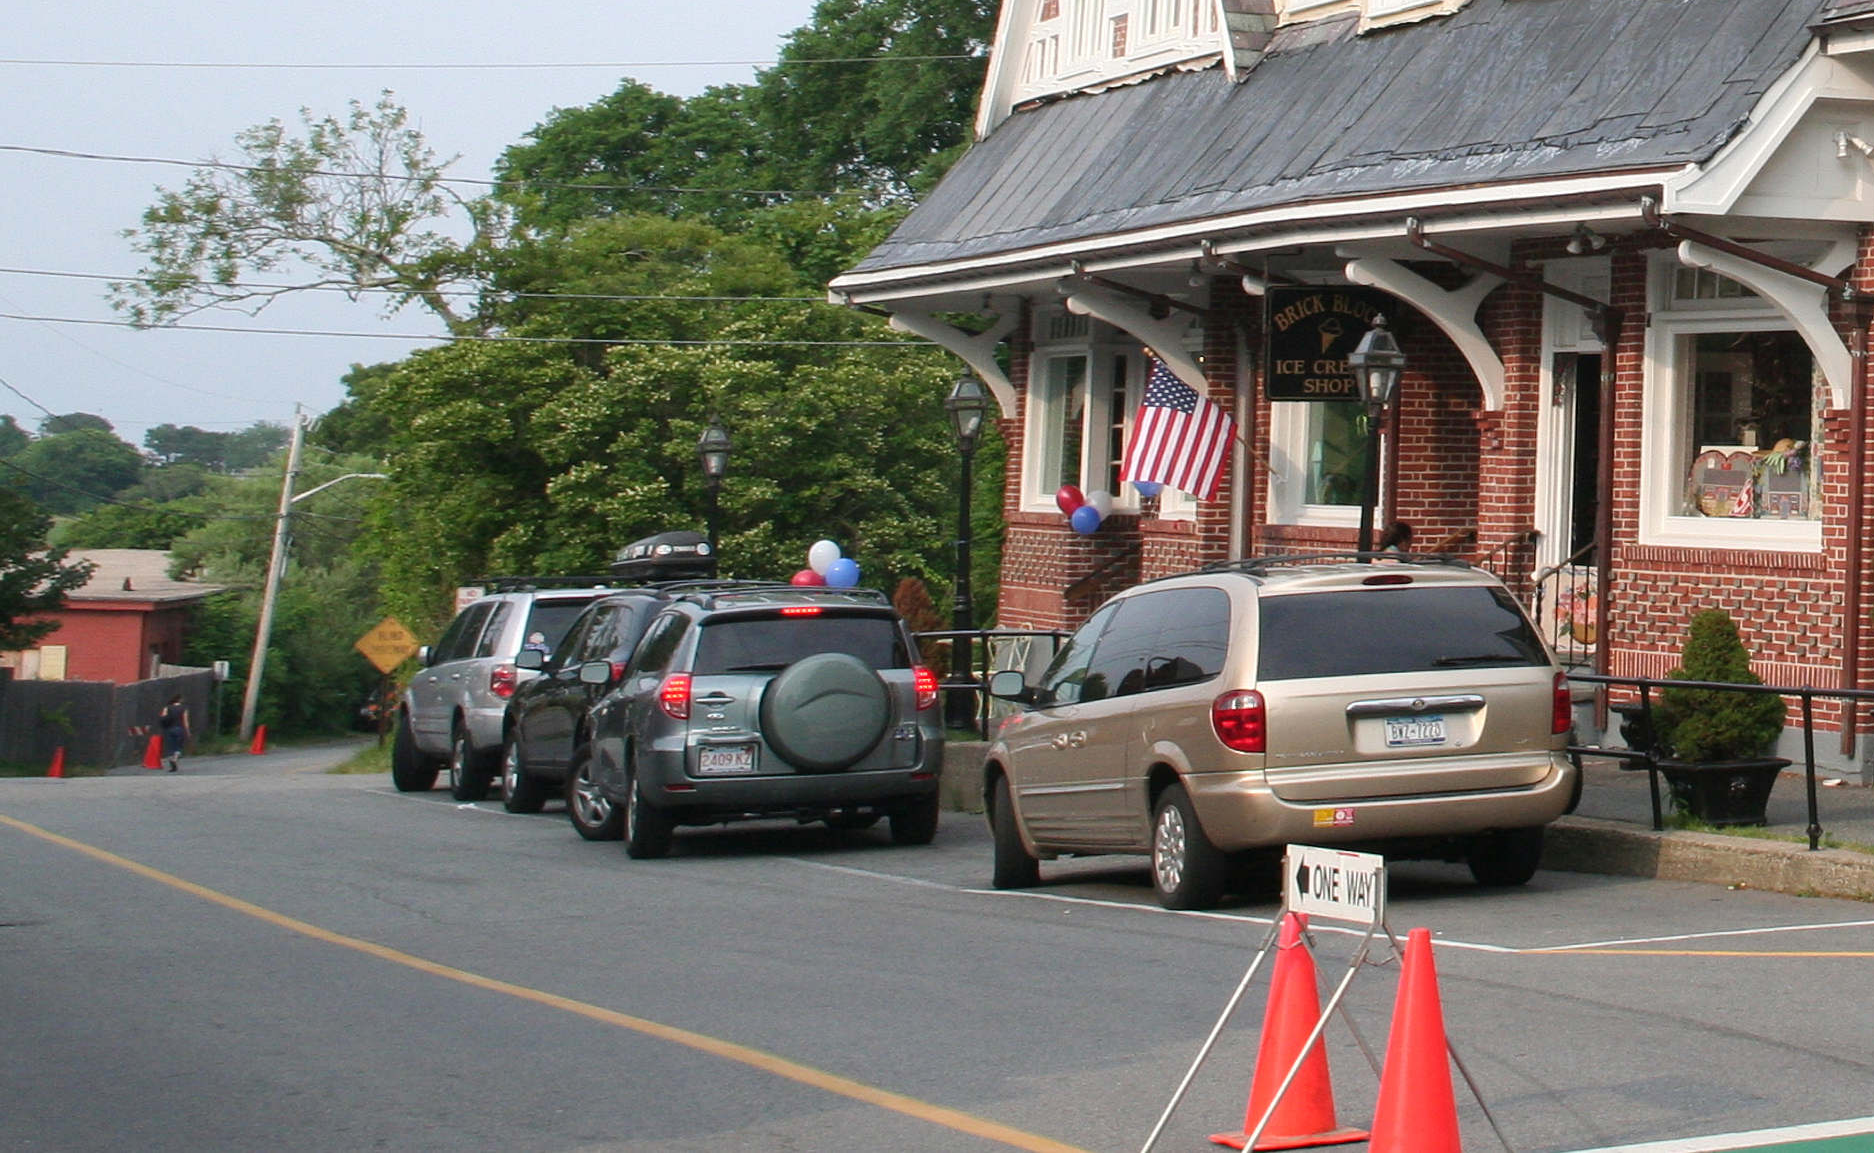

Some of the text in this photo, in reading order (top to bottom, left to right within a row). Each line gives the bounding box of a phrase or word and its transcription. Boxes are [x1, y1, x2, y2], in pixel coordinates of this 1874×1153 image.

[1273, 294, 1376, 331] BRICK BLOC
[1275, 359, 1357, 375] ICE CRE
[1303, 378, 1355, 394] SHOP
[1313, 864, 1375, 907] ONE WAY
